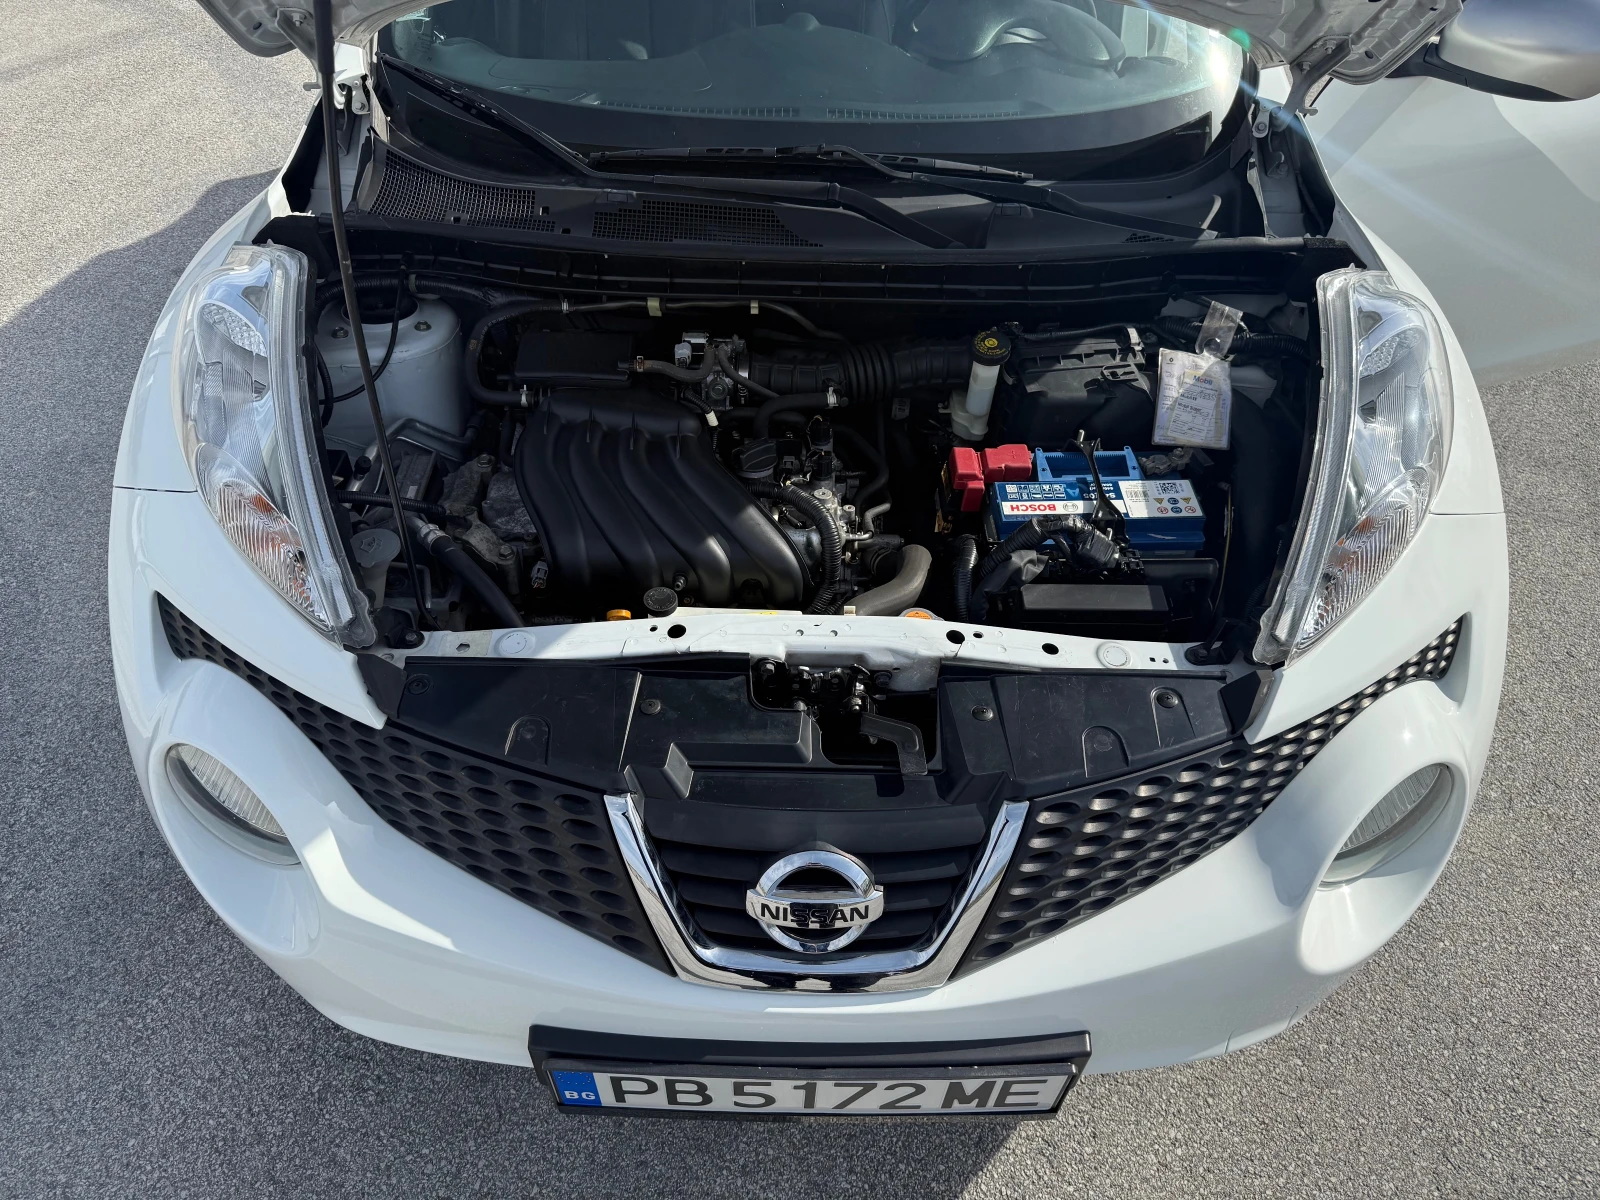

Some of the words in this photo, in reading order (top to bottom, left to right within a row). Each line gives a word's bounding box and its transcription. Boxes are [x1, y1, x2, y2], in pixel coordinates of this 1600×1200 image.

[1193, 375, 1213, 386] Mobil
[1010, 503, 1057, 512] BOSCH
[760, 901, 870, 924] NISSAN
[564, 1089, 596, 1101] BG
[609, 1076, 714, 1107] PB
[733, 1081, 927, 1110] 5172
[940, 1079, 1048, 1109] ME
